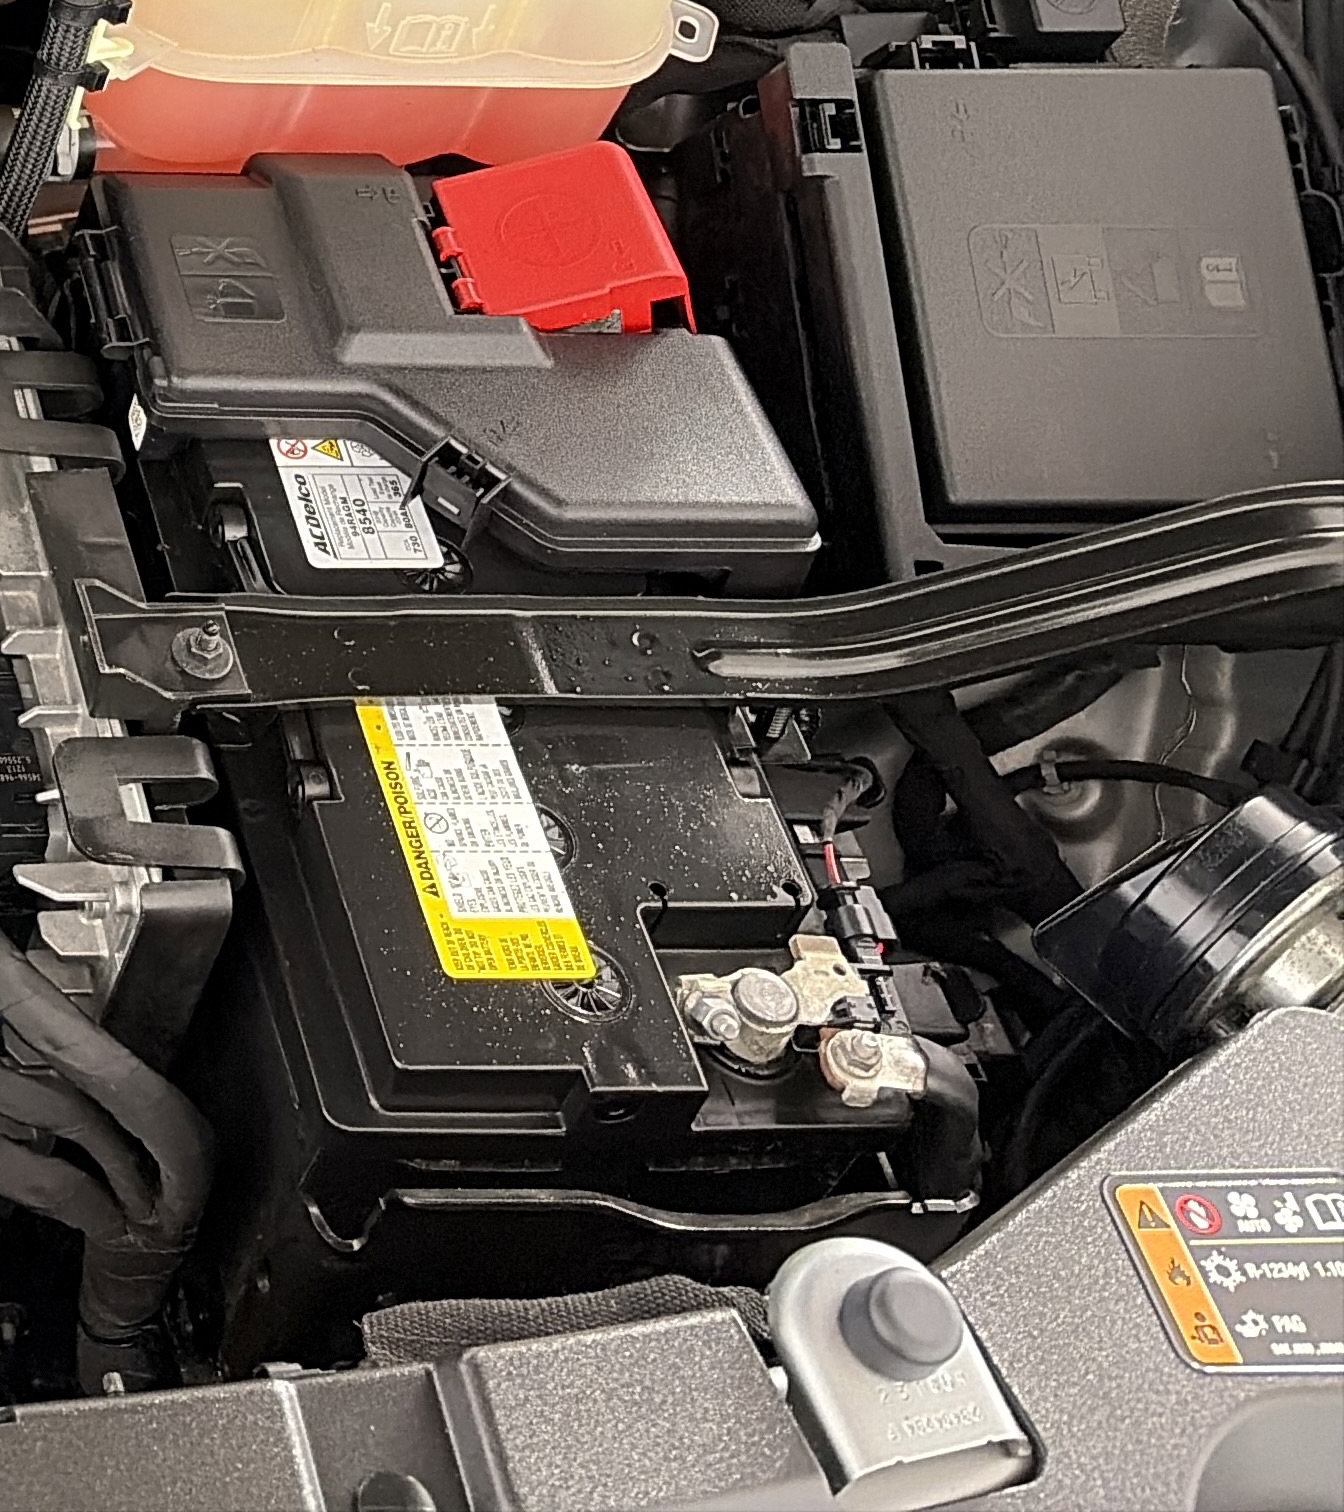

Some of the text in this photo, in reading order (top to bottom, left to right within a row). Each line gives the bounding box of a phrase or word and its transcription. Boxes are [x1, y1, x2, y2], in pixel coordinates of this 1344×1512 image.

[389, 479, 401, 497] 365
[294, 473, 331, 555] ACDelco
[339, 497, 360, 536] 94RAGM
[353, 498, 375, 534] 8540
[409, 536, 422, 553] 730
[381, 760, 435, 881] DANGER/POISON
